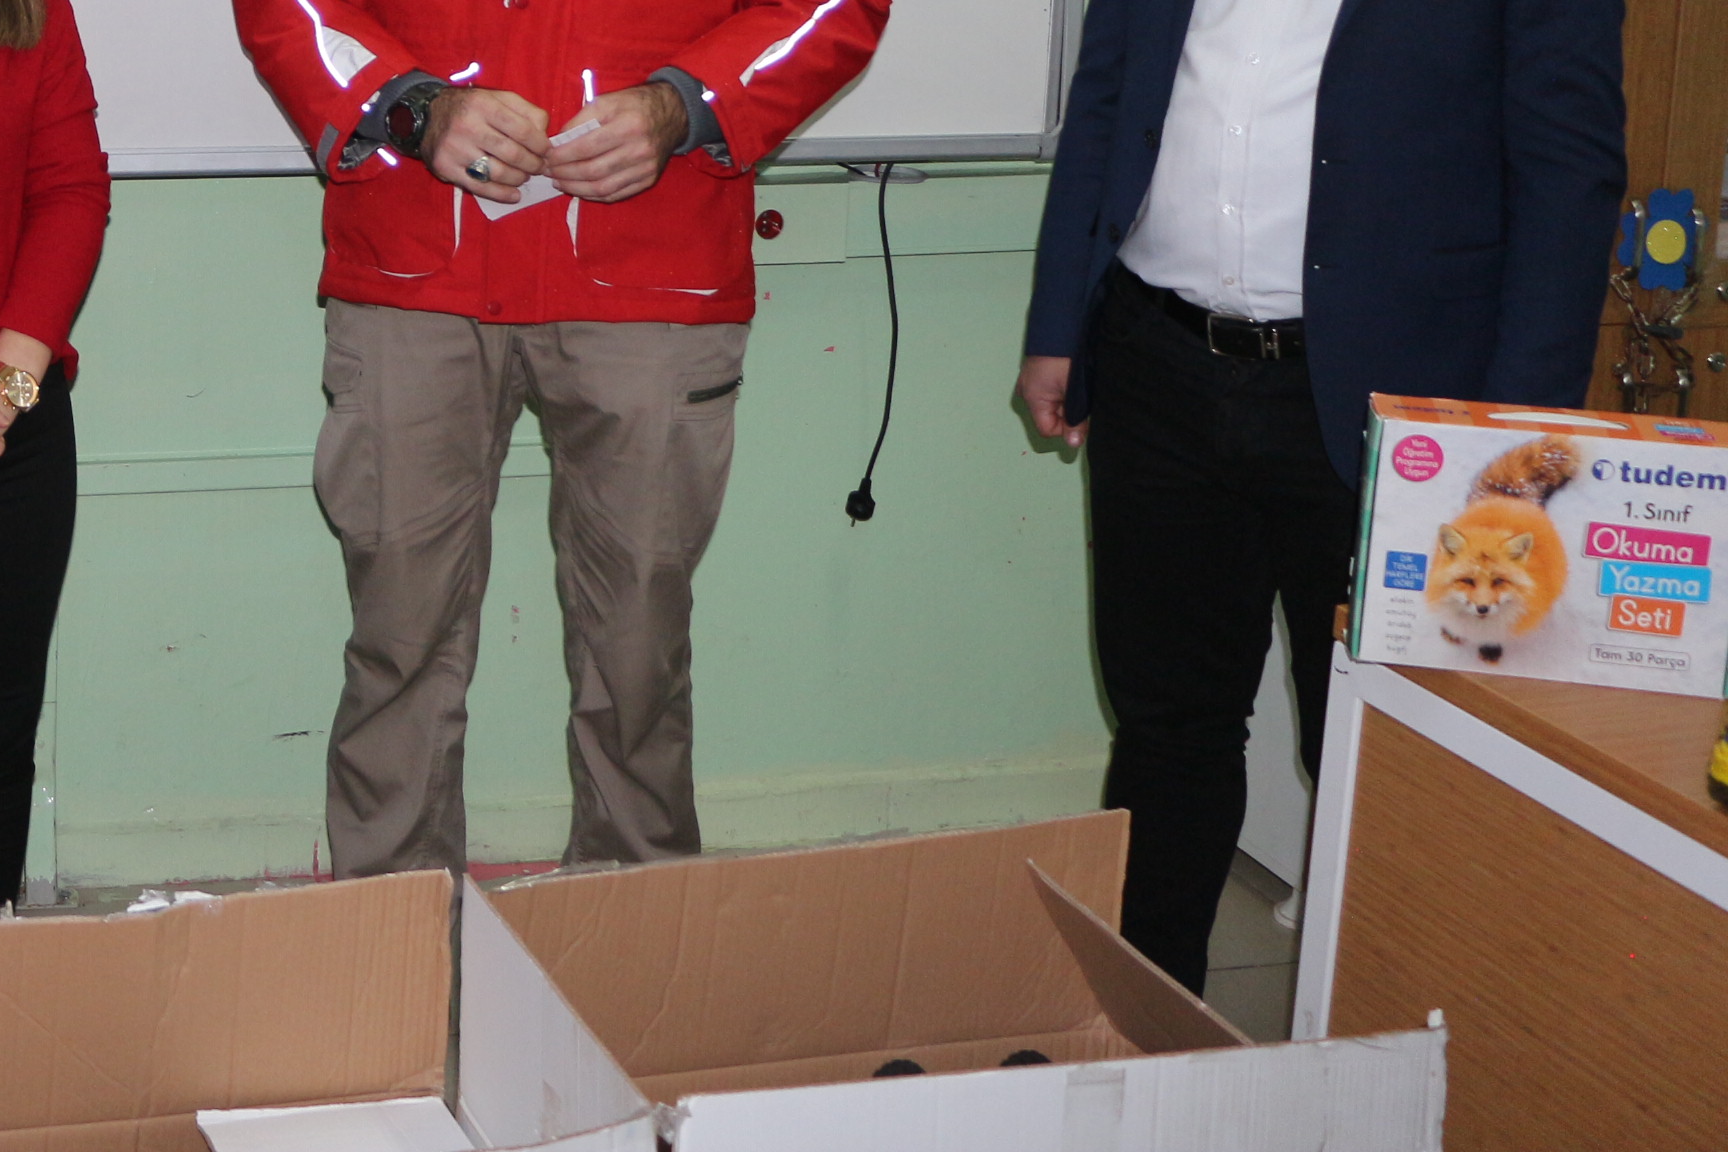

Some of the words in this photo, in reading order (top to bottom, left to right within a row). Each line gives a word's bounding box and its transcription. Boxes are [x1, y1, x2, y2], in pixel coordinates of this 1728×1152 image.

[1620, 461, 1727, 491] tudem
[1624, 501, 1639, 519] 1.
[1643, 503, 1693, 523] Sınıf
[1593, 527, 1693, 563] Okuma
[1609, 564, 1700, 596] Yazma
[1618, 599, 1672, 630] Seti
[1595, 648, 1622, 661] Tam
[1626, 651, 1643, 663] 30
[1648, 653, 1686, 667] Parça
